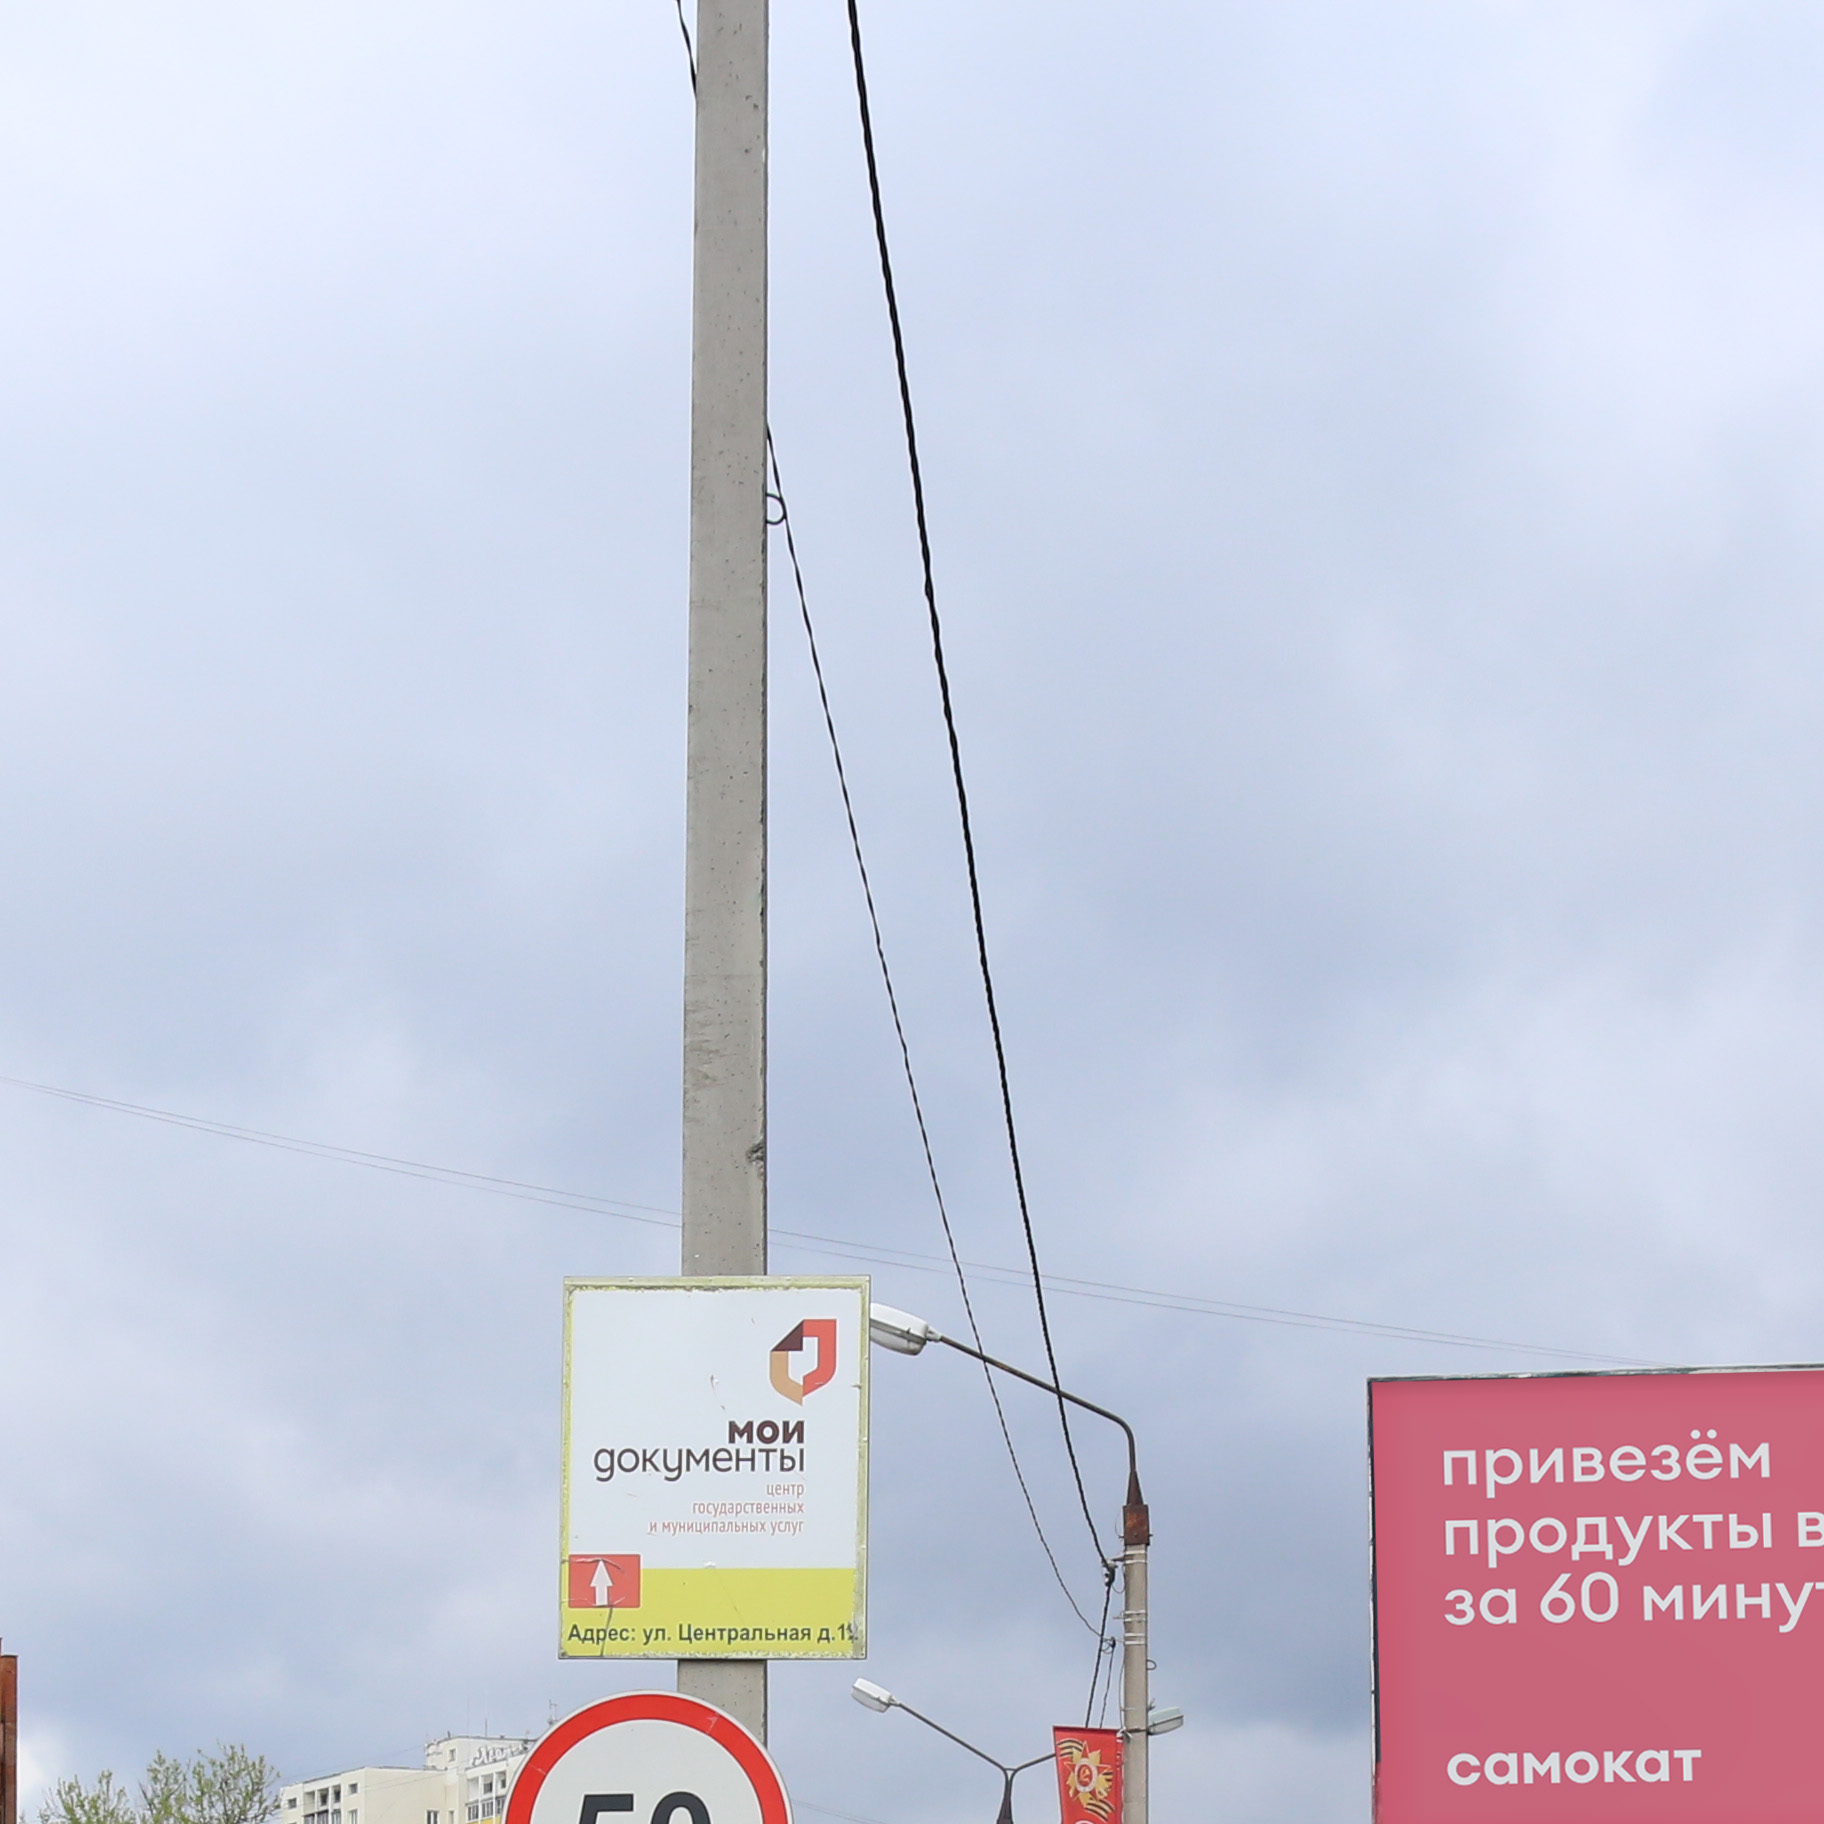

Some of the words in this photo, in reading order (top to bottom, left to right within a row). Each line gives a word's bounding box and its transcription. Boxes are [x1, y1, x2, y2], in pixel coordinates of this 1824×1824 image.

[727, 1420, 806, 1445] мои
[592, 1446, 806, 1483] документы
[1442, 1429, 1772, 1498] привезём
[766, 1481, 806, 1498] центр
[691, 1501, 806, 1518] государственных
[649, 1520, 658, 1533] и
[662, 1519, 767, 1534] муниципальных
[770, 1519, 806, 1537] услуг
[1444, 1503, 1774, 1569] продукты
[1443, 1580, 1519, 1627] за
[1537, 1570, 1620, 1624] 60
[567, 1623, 636, 1645] Адрес:
[642, 1627, 672, 1645] ул.
[678, 1623, 812, 1645] Центральная
[1446, 1745, 1703, 1789] самокат
